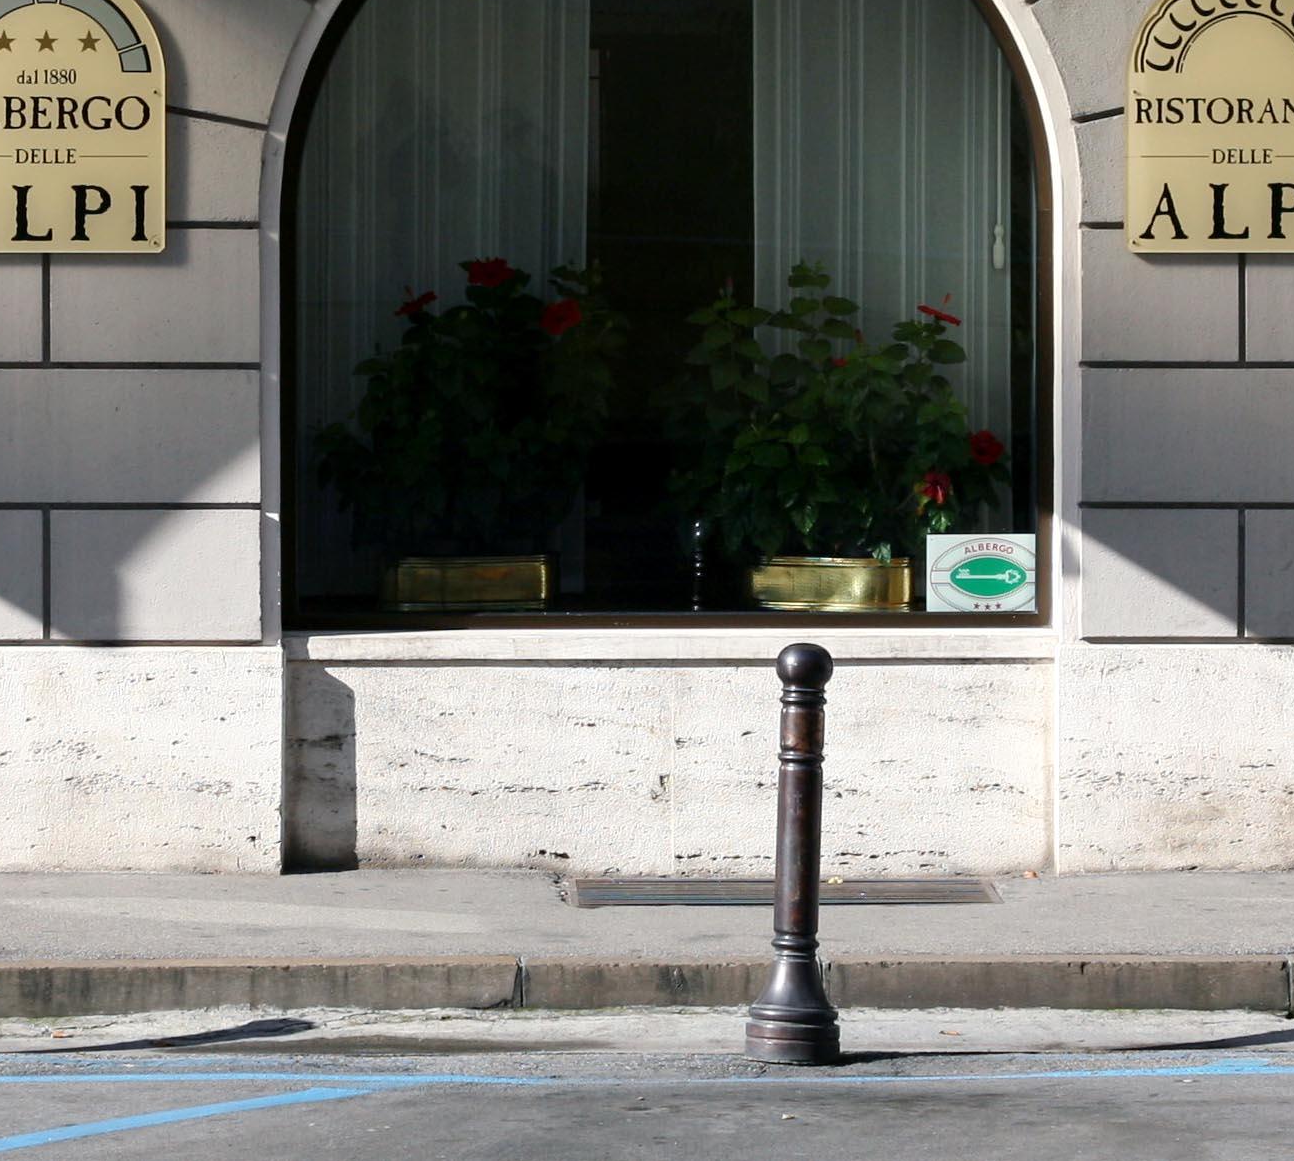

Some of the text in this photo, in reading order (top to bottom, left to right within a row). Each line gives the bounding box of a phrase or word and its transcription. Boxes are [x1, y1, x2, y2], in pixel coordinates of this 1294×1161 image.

[16, 68, 77, 85] dal 1880
[14, 148, 77, 165] DELLE
[1211, 148, 1273, 165] DELLE
[964, 542, 1015, 555] ALBERGO
